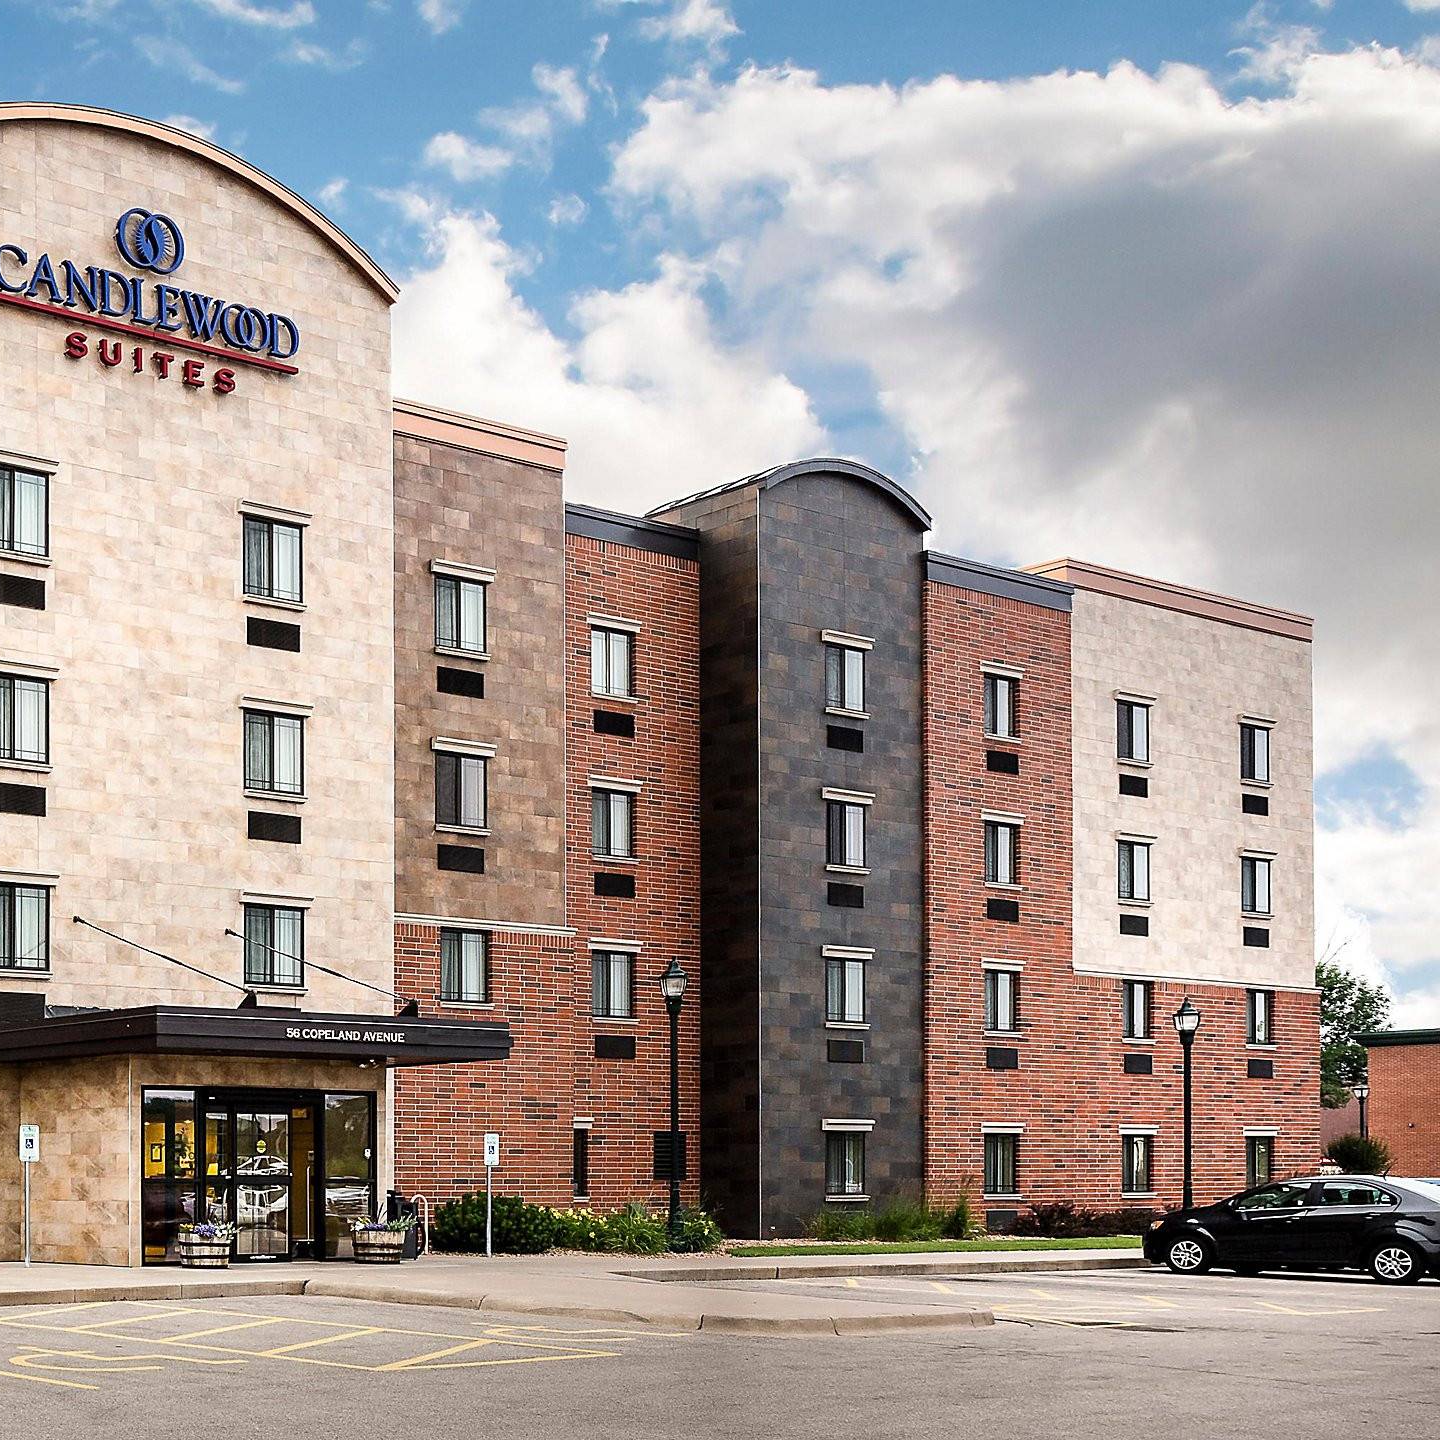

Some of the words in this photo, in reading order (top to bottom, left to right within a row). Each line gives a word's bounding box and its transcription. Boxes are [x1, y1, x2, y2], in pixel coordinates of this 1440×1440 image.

[65, 331, 237, 394] SUITES
[286, 1028, 300, 1038] 56
[302, 1028, 360, 1041] COPELAND
[363, 1031, 405, 1043] AVENUE
